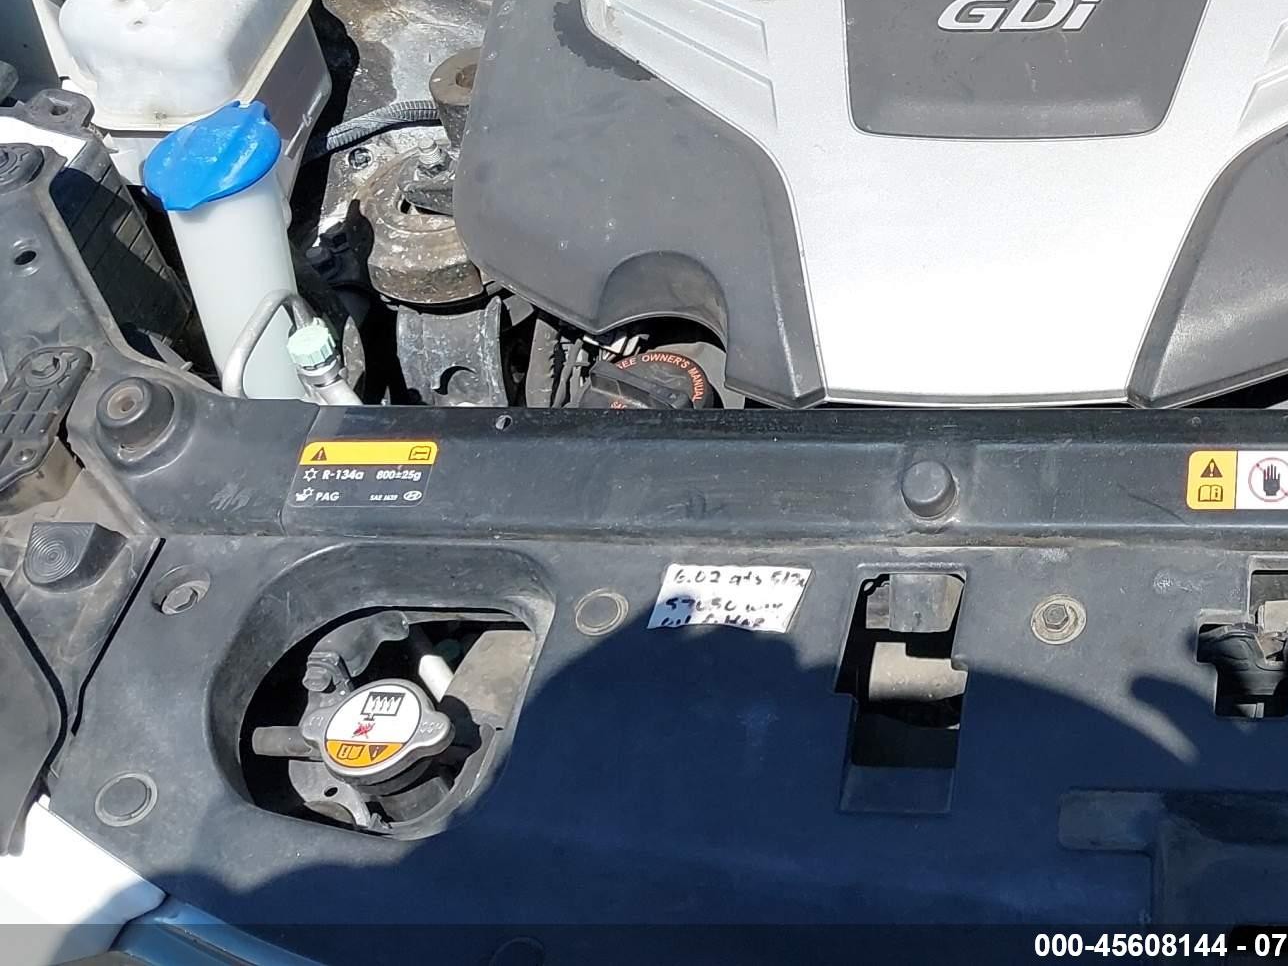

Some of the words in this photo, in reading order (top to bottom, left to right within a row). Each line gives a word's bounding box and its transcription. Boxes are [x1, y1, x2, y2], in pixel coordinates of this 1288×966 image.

[641, 353, 690, 369] OWNER'S
[688, 367, 704, 402] MANUAL
[322, 469, 365, 480] R-134a
[376, 469, 422, 482] 800±25g
[315, 491, 341, 502] PAG
[674, 568, 721, 584] 6.02
